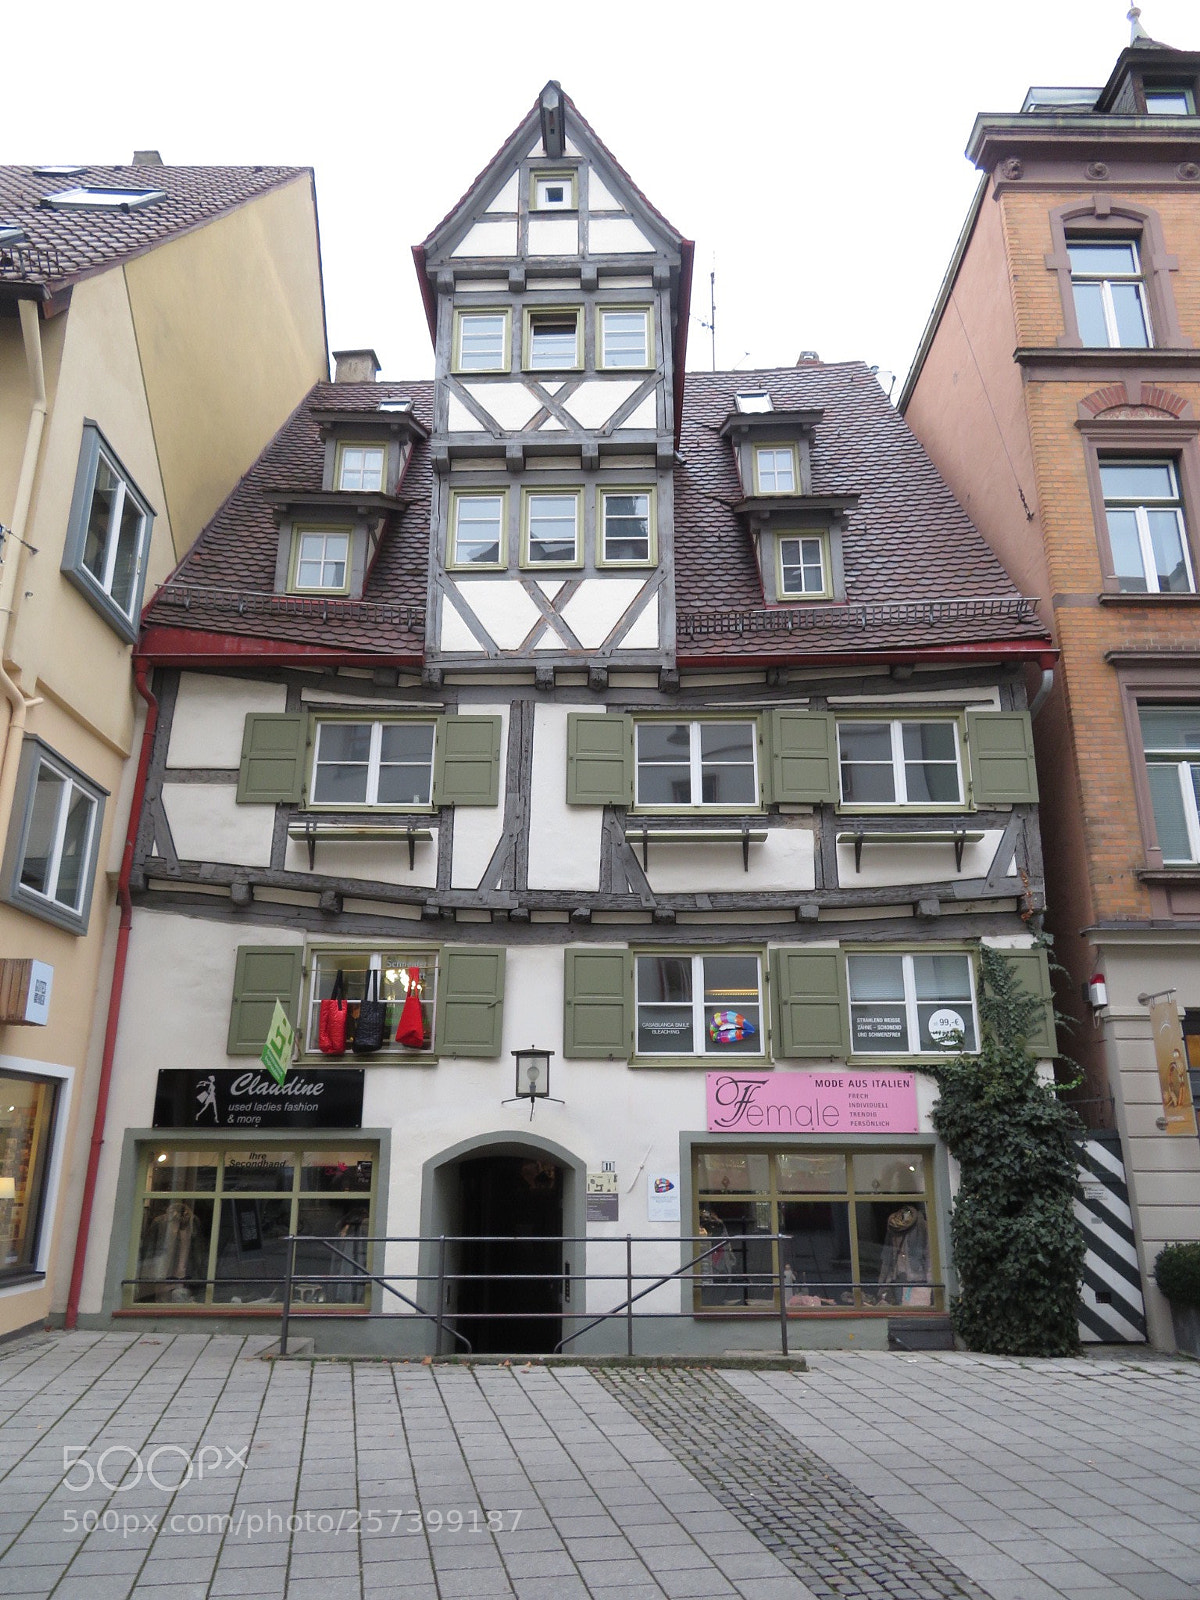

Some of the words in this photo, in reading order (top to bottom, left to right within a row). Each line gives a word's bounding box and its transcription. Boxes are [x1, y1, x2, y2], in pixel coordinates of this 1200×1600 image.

[230, 1072, 325, 1096] Claudine
[815, 1079, 844, 1088] MODE
[848, 1079, 868, 1088] AUS
[872, 1079, 910, 1088] ITALIEN
[714, 1076, 840, 1128] Female
[228, 1102, 252, 1112] used
[253, 1102, 282, 1112] ladies
[283, 1102, 319, 1112] fashion
[227, 1114, 235, 1124] &
[236, 1115, 262, 1124] more
[850, 1119, 890, 1127] PERSÖNLICH
[248, 1152, 267, 1160] Ihre
[229, 1159, 287, 1168] Secondhand
